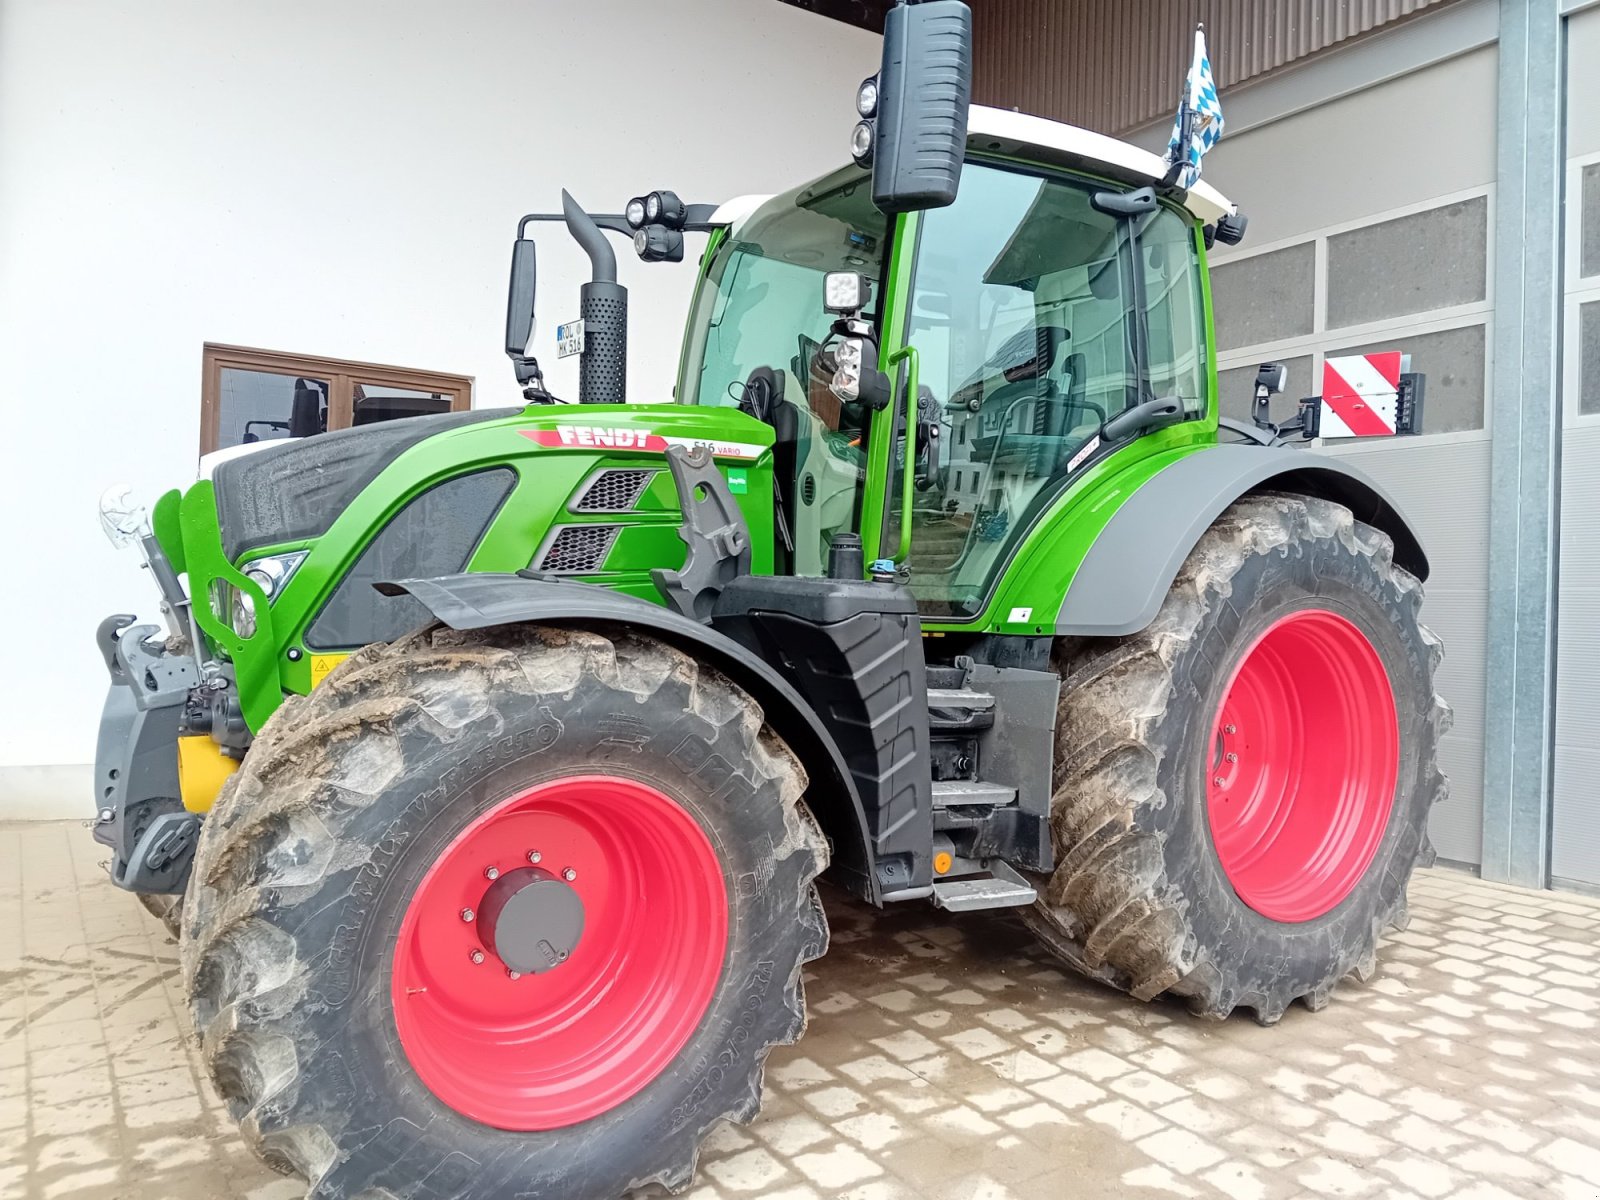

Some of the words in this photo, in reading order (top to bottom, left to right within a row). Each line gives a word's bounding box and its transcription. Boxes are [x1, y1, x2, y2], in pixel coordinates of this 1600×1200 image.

[569, 337, 582, 353] 516
[556, 425, 651, 448] FENDT
[718, 447, 741, 456] VARIO
